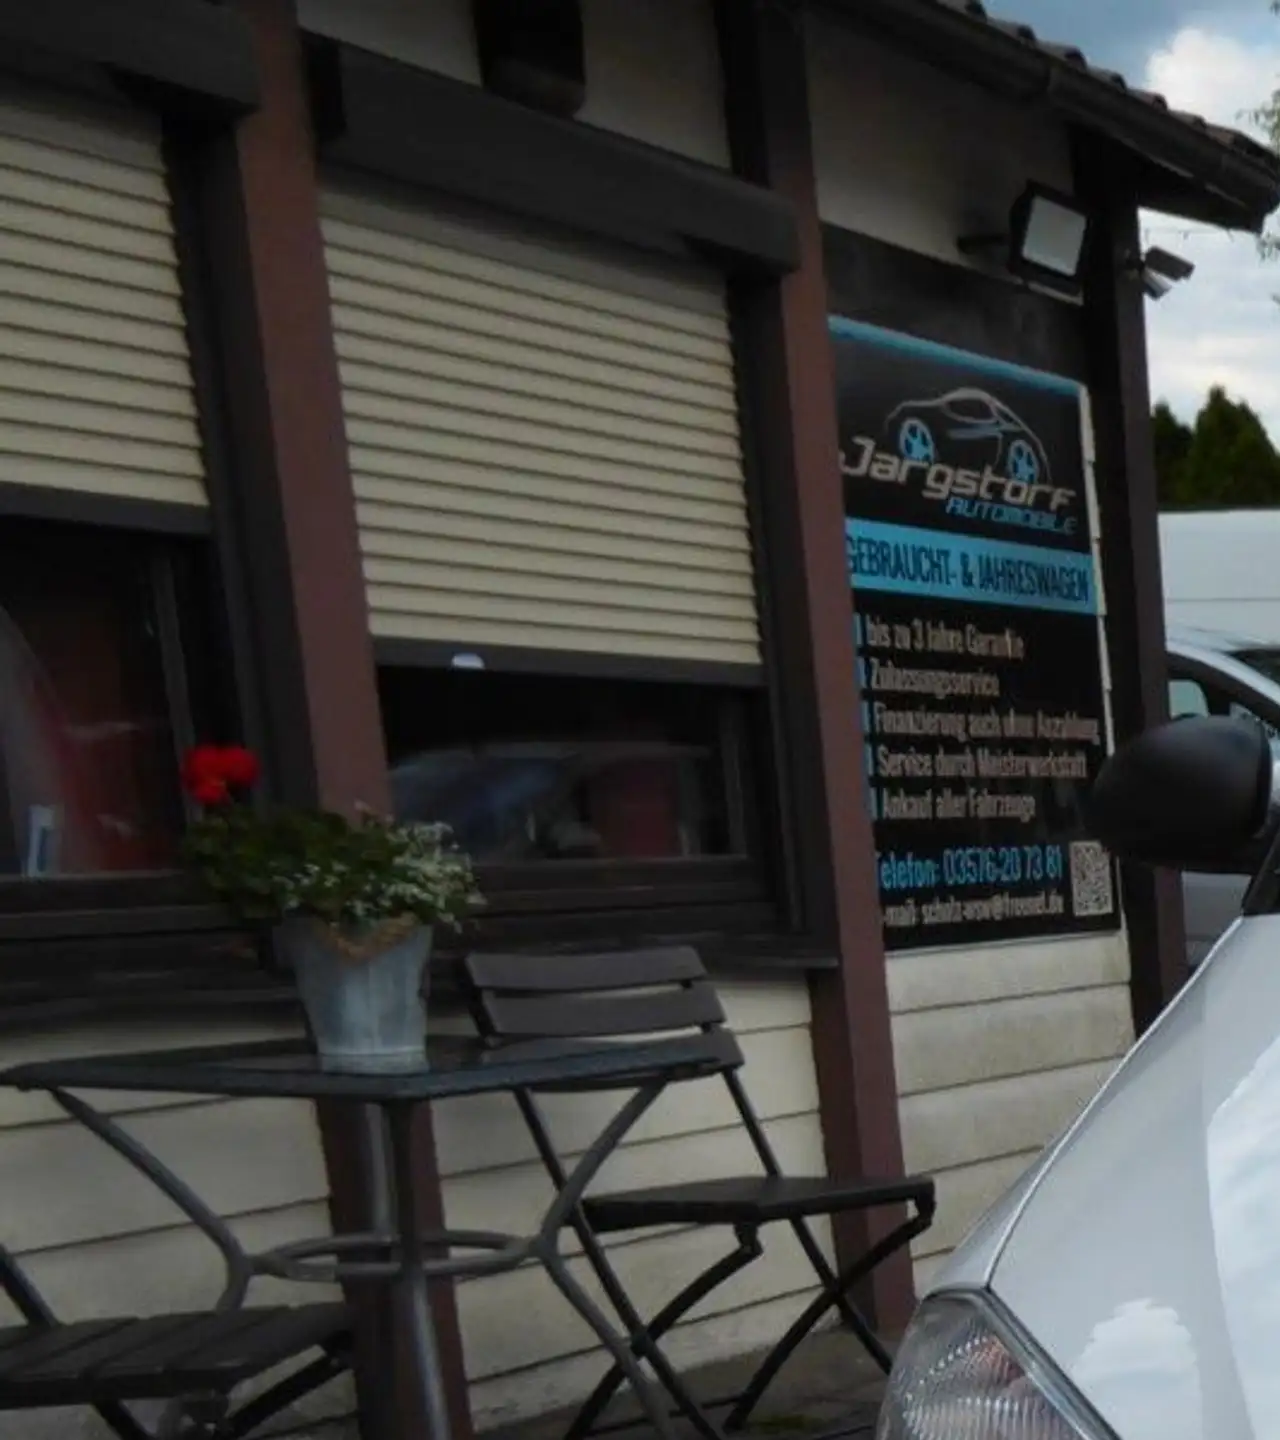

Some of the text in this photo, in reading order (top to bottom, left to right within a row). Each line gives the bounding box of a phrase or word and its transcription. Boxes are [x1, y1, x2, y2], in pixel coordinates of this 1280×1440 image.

[960, 551, 975, 588] &
[979, 554, 1090, 604] JAHRESWAGEN
[912, 618, 923, 650] 3
[966, 624, 1024, 660] Garantie
[874, 702, 967, 742] Finanzierung
[877, 746, 931, 776] Service
[936, 746, 975, 777] durch
[883, 788, 931, 819] Ankauf
[970, 788, 1035, 823] Fahrzeuge
[1025, 846, 1042, 879] 73
